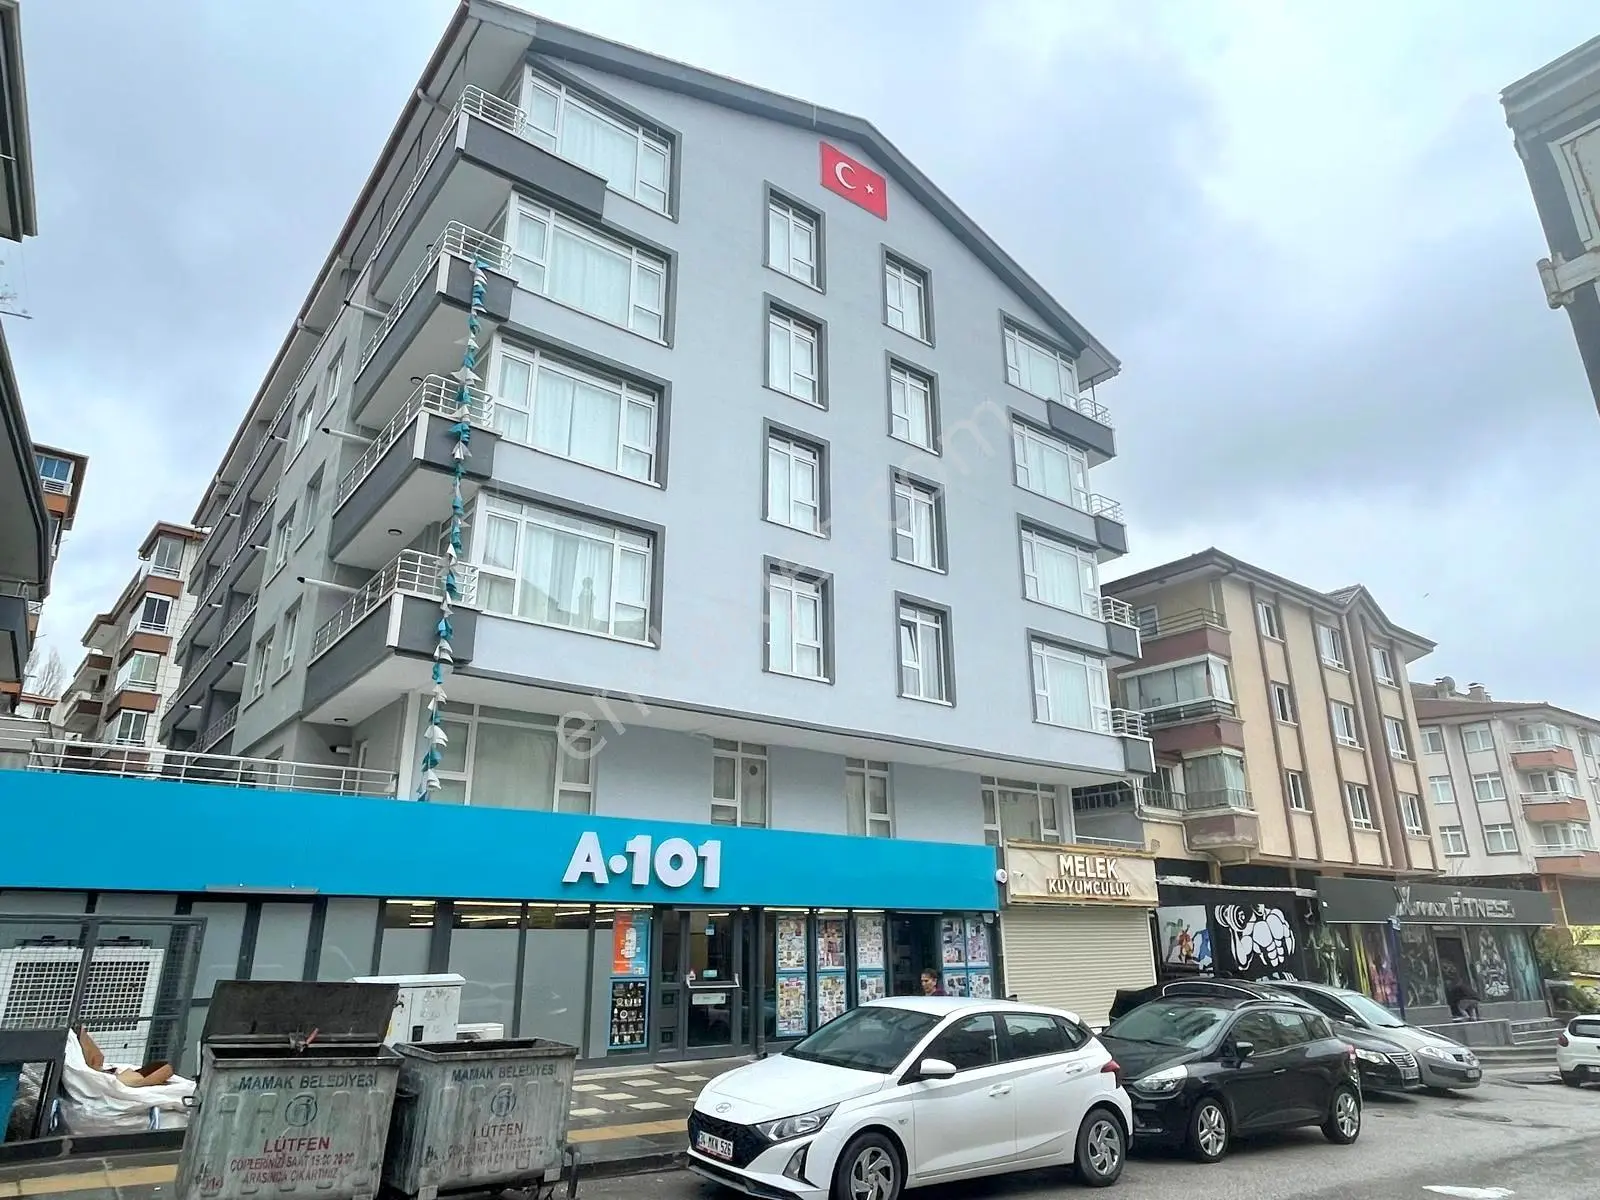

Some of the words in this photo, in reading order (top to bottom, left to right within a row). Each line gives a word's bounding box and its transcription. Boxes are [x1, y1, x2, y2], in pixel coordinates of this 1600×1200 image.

[1058, 854, 1119, 879] MELEK
[1048, 878, 1132, 897] KUYUMCULUK
[239, 1075, 295, 1091] MAMAK
[452, 1068, 494, 1081] MAMAK
[263, 1135, 331, 1153] LÜTFEN
[720, 1140, 732, 1156] 526
